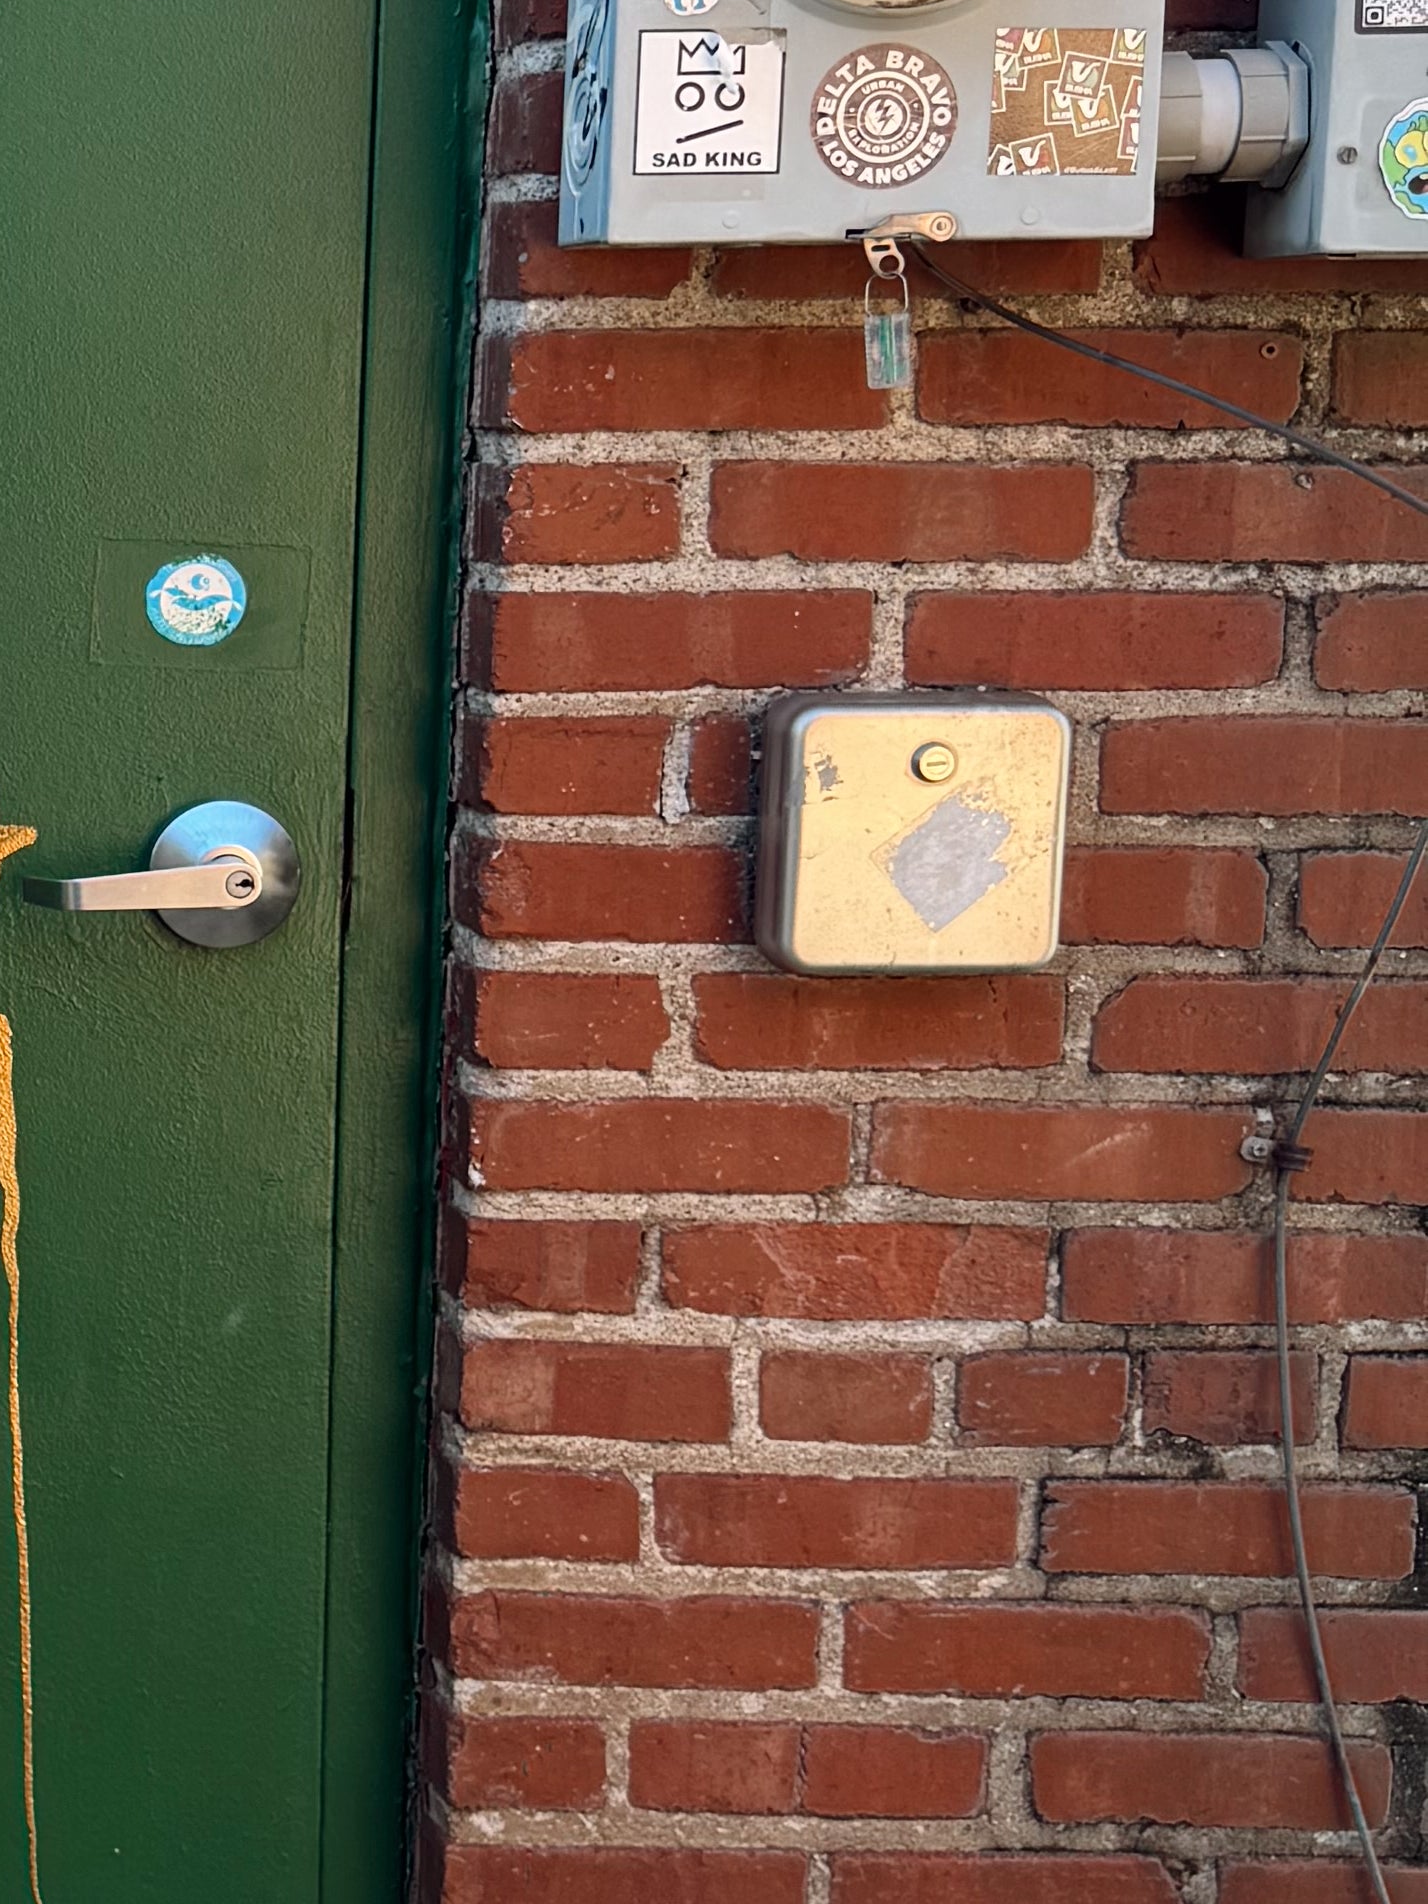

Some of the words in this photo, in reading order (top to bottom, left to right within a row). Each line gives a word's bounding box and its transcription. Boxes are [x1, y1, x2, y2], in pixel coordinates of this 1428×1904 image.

[816, 54, 876, 137] DELTA
[885, 49, 952, 127] BRAVO
[861, 80, 905, 94] URBAN
[848, 122, 920, 154] EXPLORATION
[652, 152, 697, 168] SAD
[705, 151, 762, 167] KING
[823, 140, 859, 177] LOS
[857, 132, 946, 185] ANGELES
